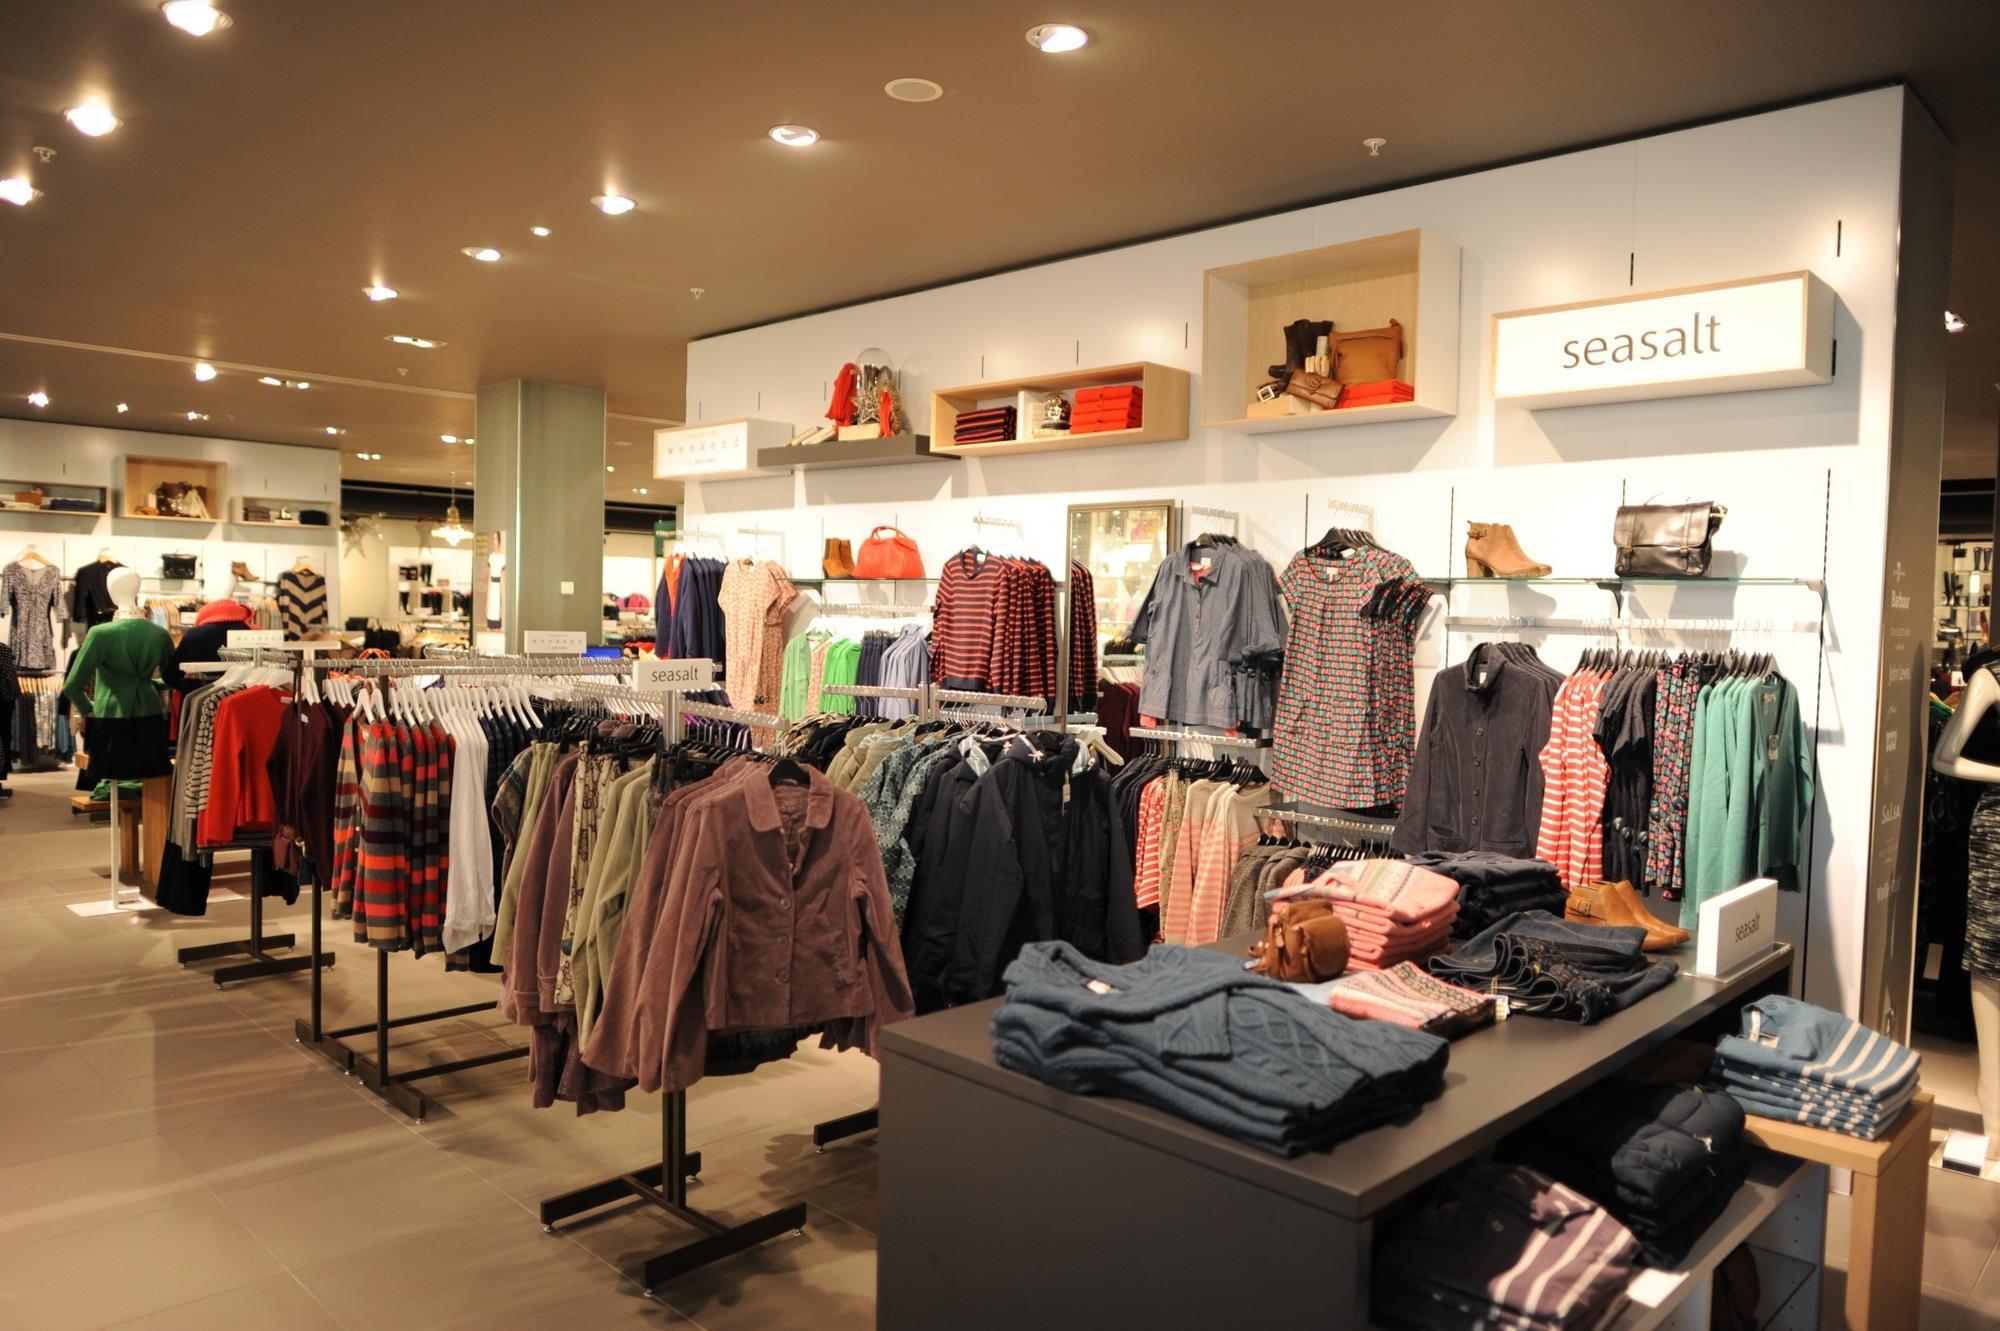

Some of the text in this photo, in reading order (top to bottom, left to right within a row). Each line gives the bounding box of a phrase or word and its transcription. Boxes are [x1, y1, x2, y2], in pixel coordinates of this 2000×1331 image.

[1562, 311, 1721, 369] seasalt
[651, 664, 699, 682] seasalt
[1734, 911, 1761, 944] seasalt
